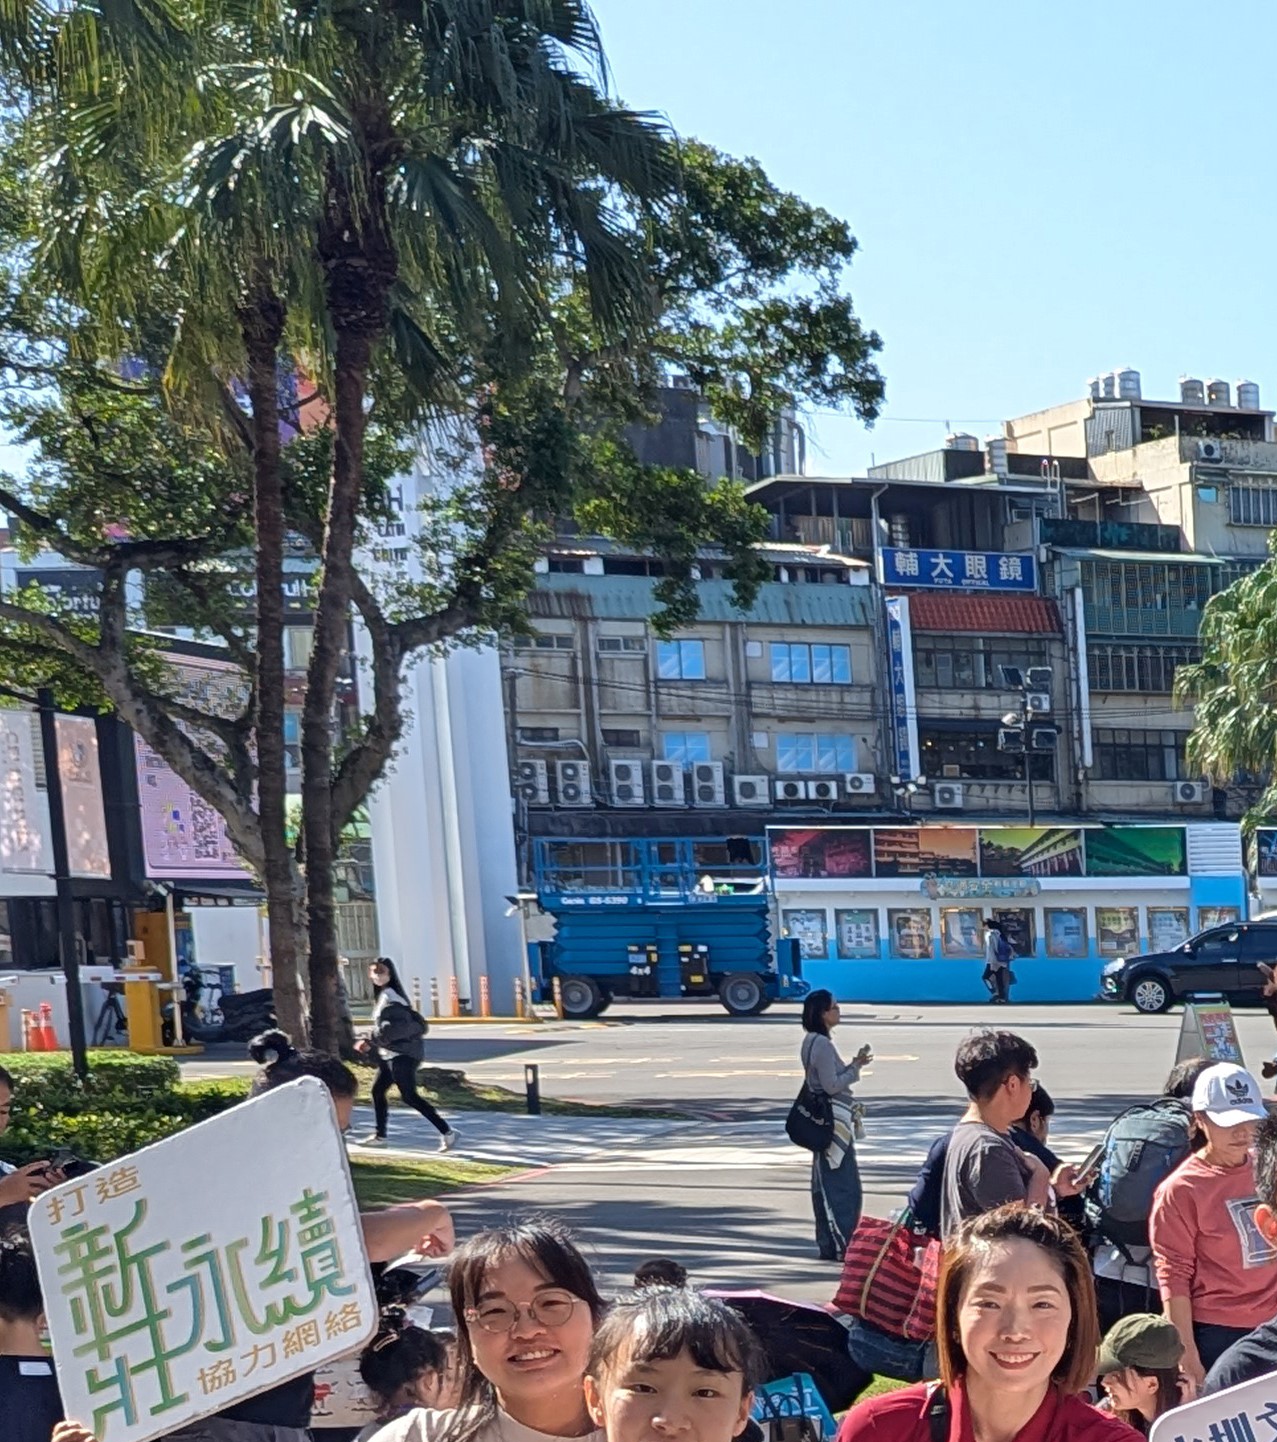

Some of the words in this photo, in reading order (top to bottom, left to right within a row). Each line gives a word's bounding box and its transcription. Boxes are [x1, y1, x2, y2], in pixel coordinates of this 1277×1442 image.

[894, 551, 1023, 581] 輔大眼鏡
[46, 1165, 142, 1225] 打造
[197, 1303, 363, 1395] 協力網絡
